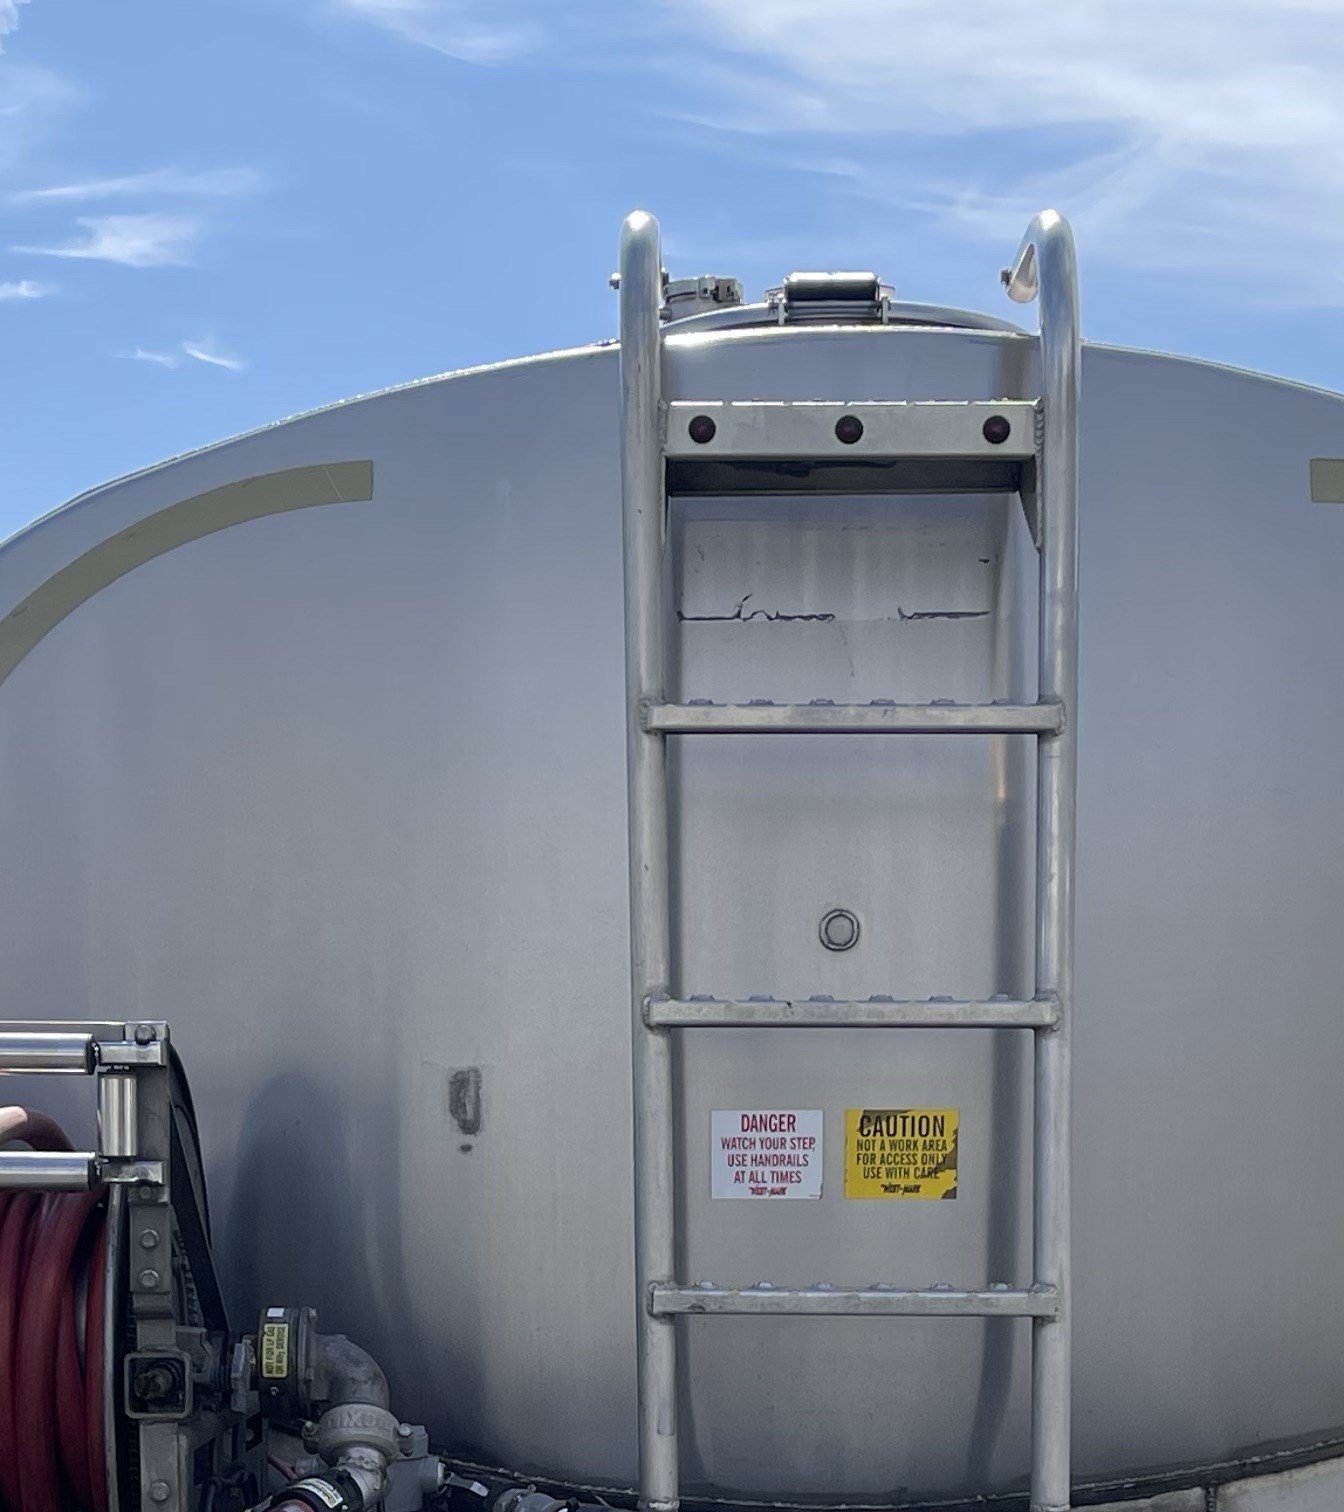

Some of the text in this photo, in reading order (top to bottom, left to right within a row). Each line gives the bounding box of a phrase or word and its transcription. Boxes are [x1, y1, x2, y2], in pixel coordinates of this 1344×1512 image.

[741, 1114, 796, 1132] DANGER
[860, 1115, 945, 1137] CAUTION
[721, 1137, 816, 1152] WATCH YOUR STEP,
[856, 1139, 947, 1151] NOT A WORK AREA
[727, 1154, 809, 1167] USE HANDRAILS
[856, 1153, 946, 1165] FOR ACCESS ONLY
[734, 1171, 802, 1183] AT ALL TIMES
[863, 1167, 940, 1179] USE WITH CARE
